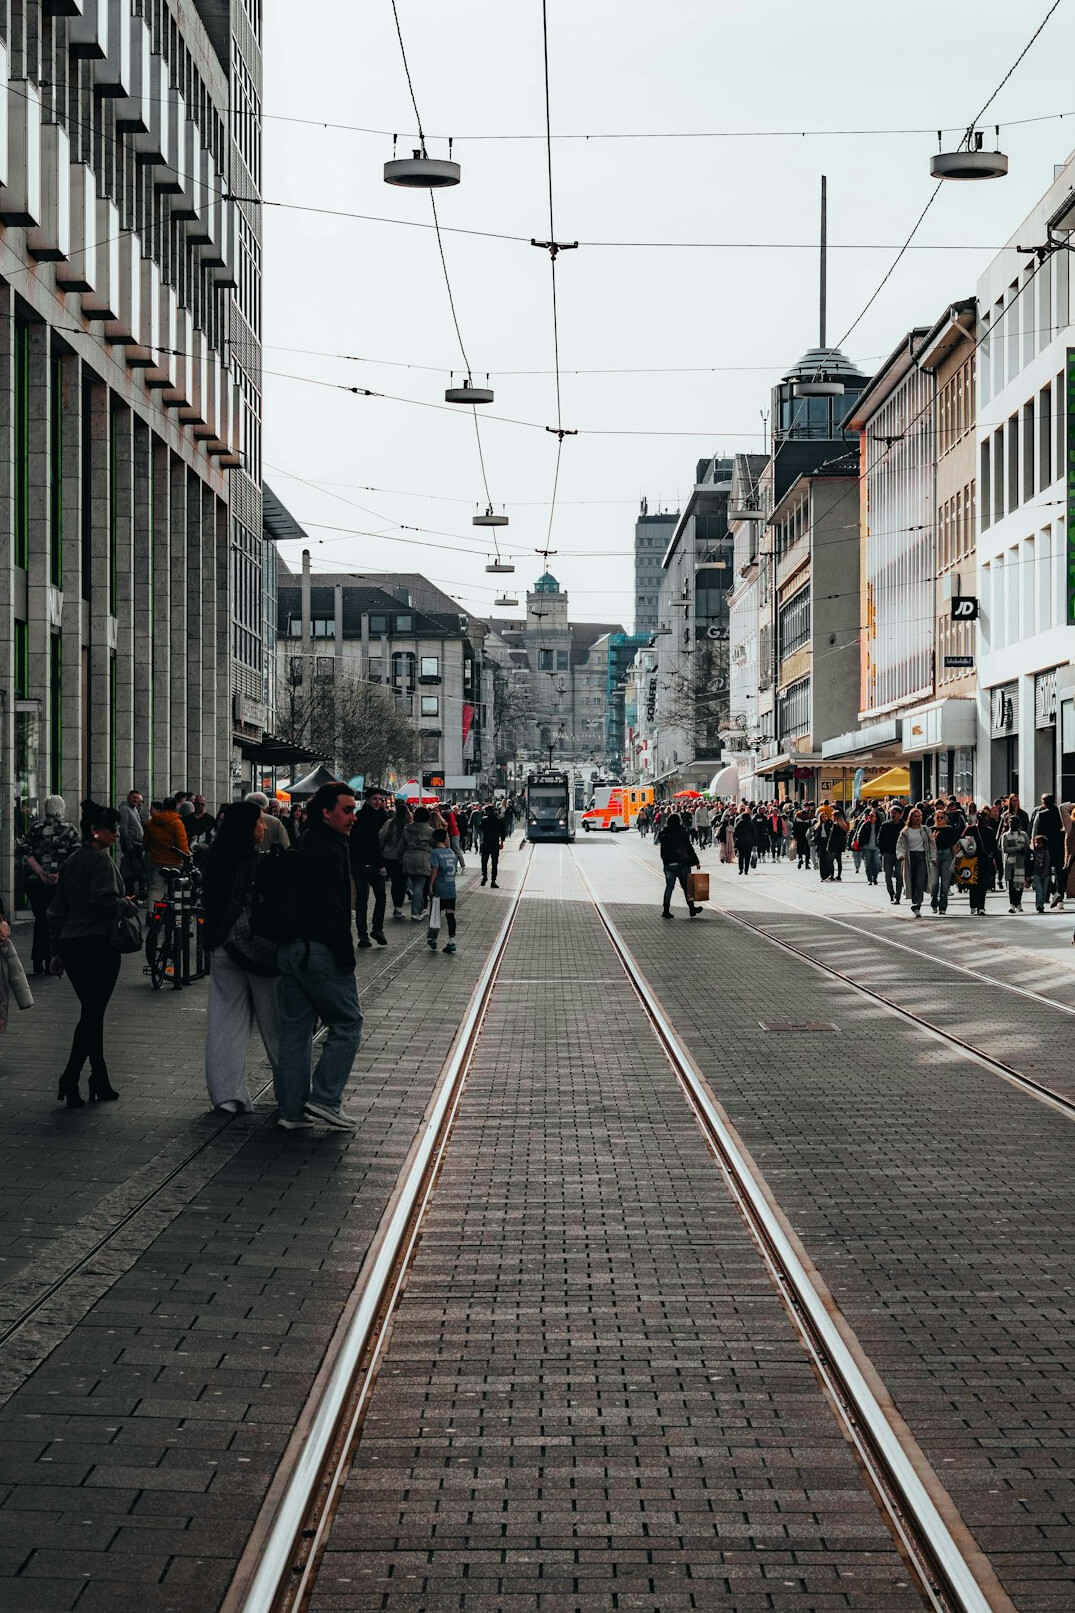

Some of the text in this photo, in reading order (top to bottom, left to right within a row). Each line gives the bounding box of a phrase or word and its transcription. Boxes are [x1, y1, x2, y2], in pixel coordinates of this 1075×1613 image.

[954, 601, 974, 615] JD
[646, 678, 658, 722] SCHÄFER
[821, 782, 831, 790] 41
[445, 858, 456, 876] 5
